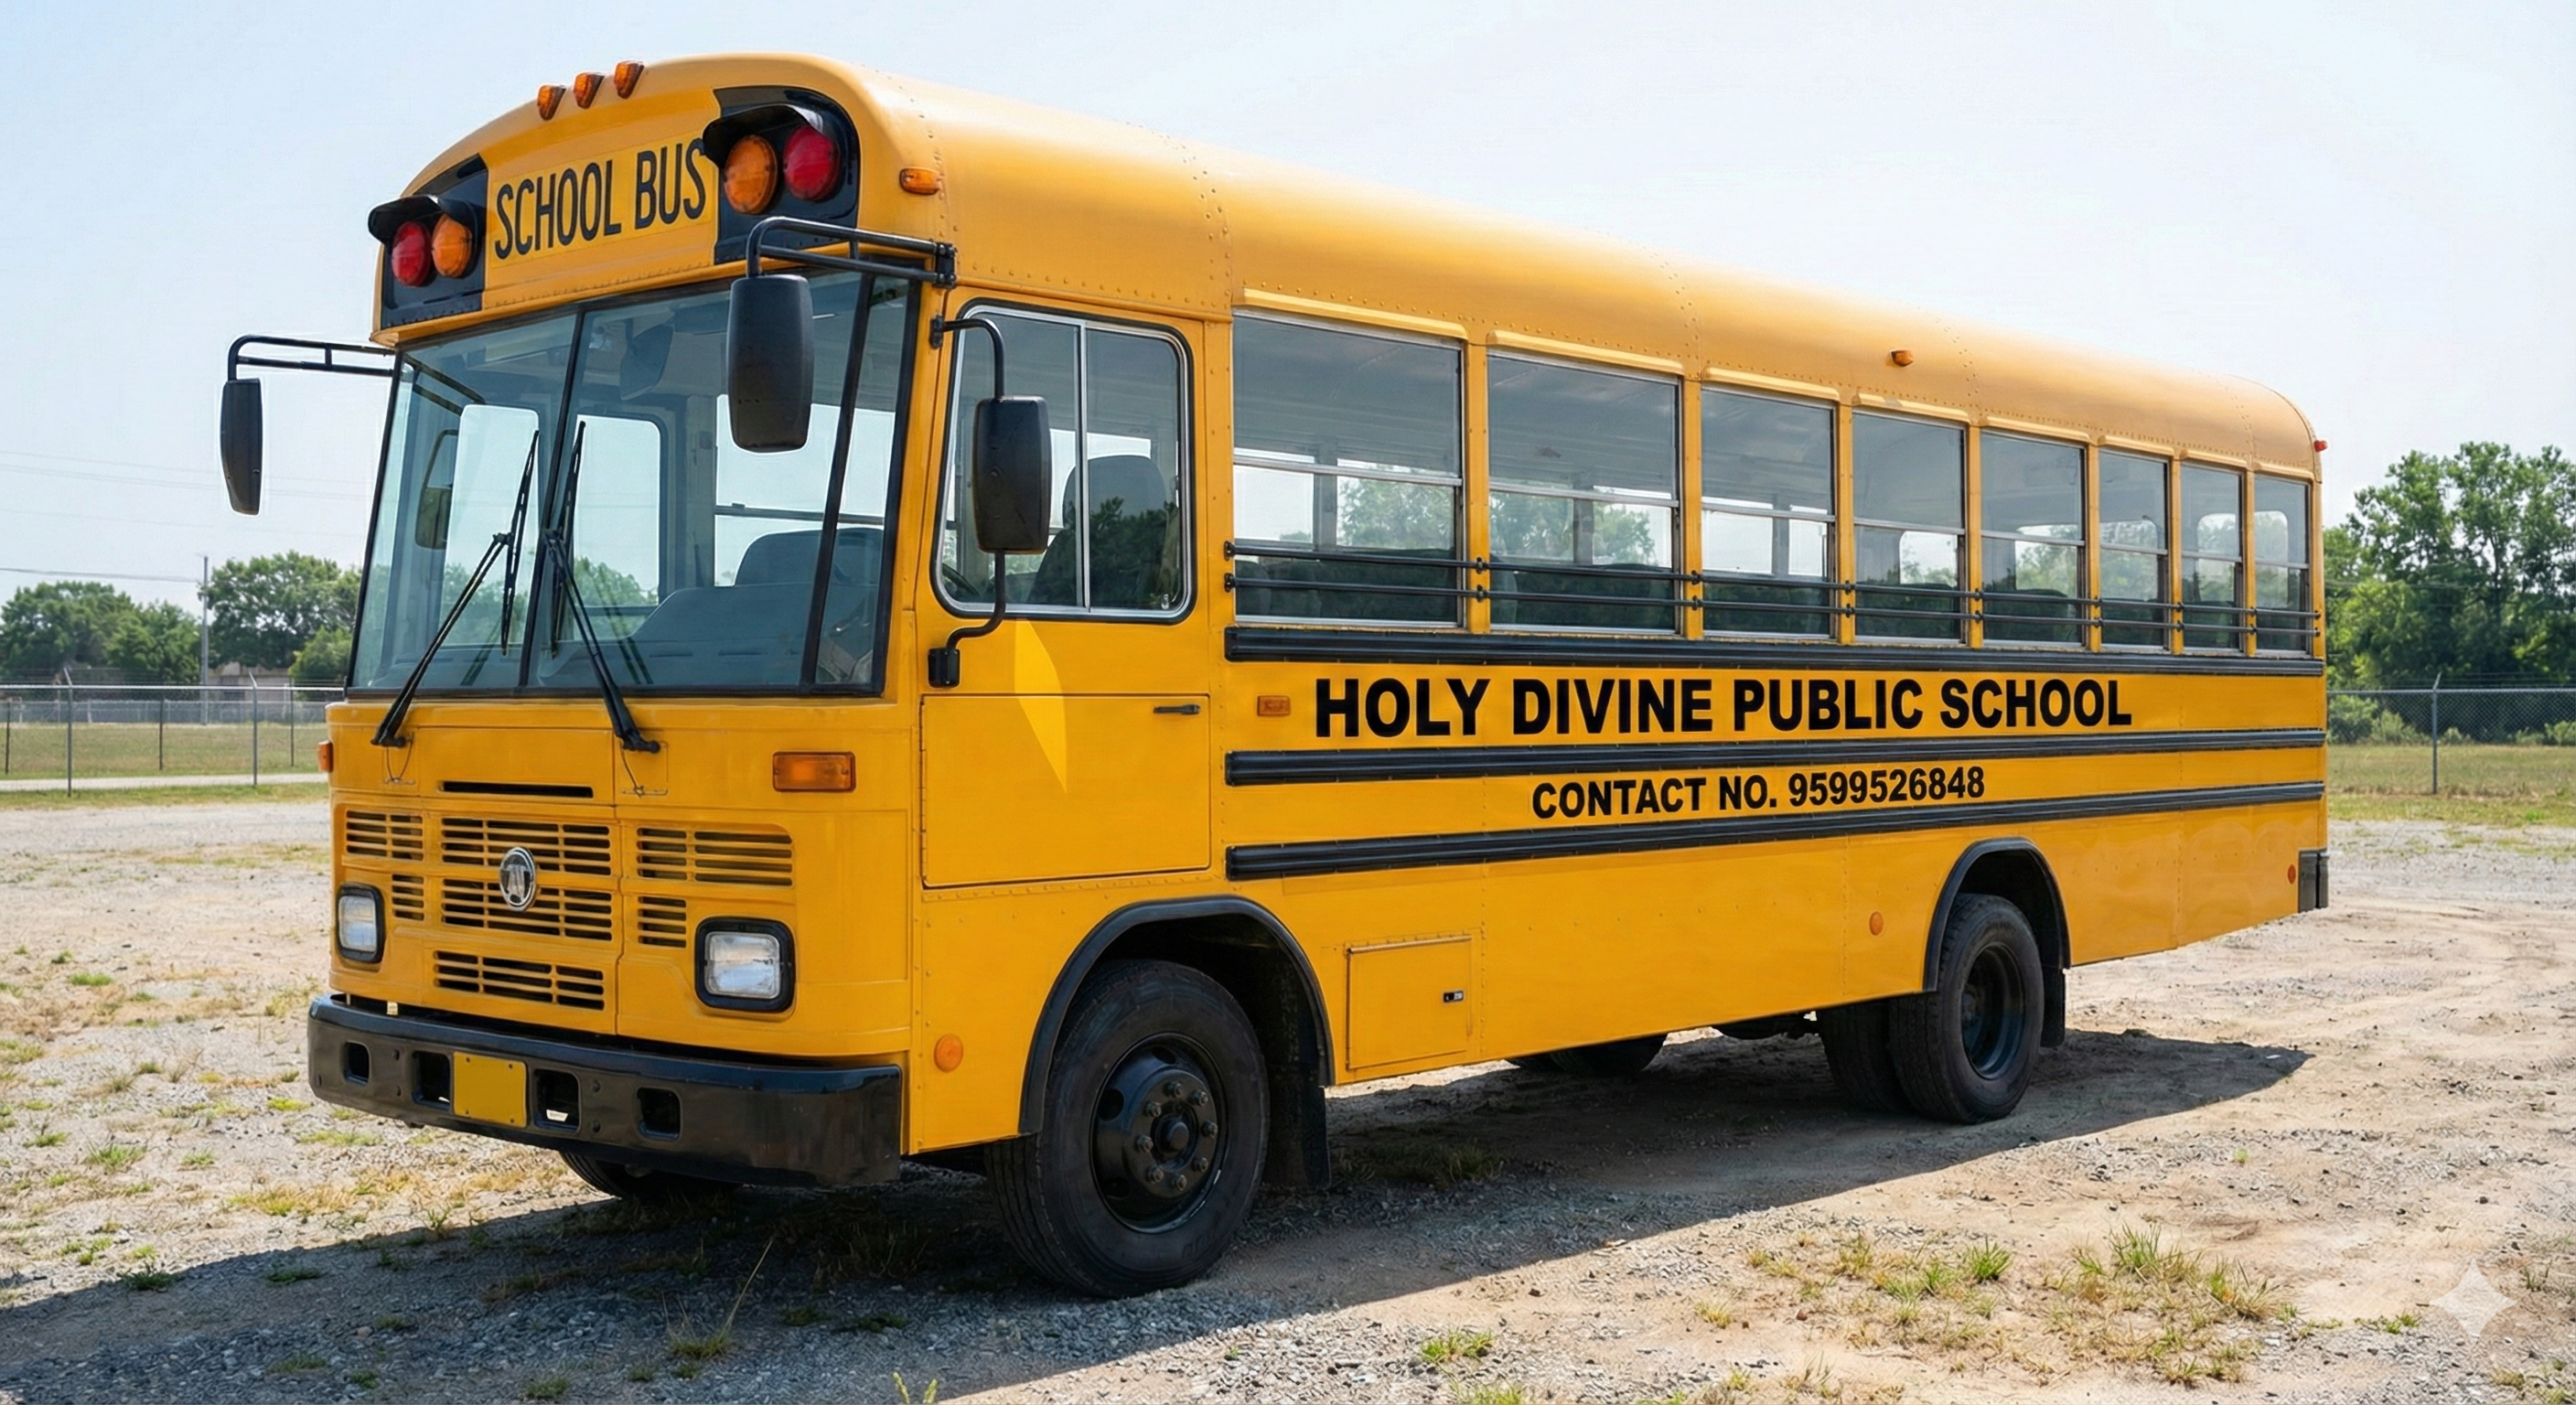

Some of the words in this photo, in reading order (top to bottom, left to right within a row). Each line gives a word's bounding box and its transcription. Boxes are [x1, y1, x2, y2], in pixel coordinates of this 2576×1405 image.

[494, 159, 623, 260] SCHOOL
[634, 136, 706, 231] BUS
[1315, 678, 1491, 738] HOLY
[1513, 678, 1714, 735] DIVINE
[1733, 678, 1924, 732] PUBLIC
[1939, 678, 2133, 729] SCHOOL
[1531, 776, 1708, 820] CONTACT
[1718, 773, 1777, 810] NO.
[1787, 765, 1986, 807] 9599526848
